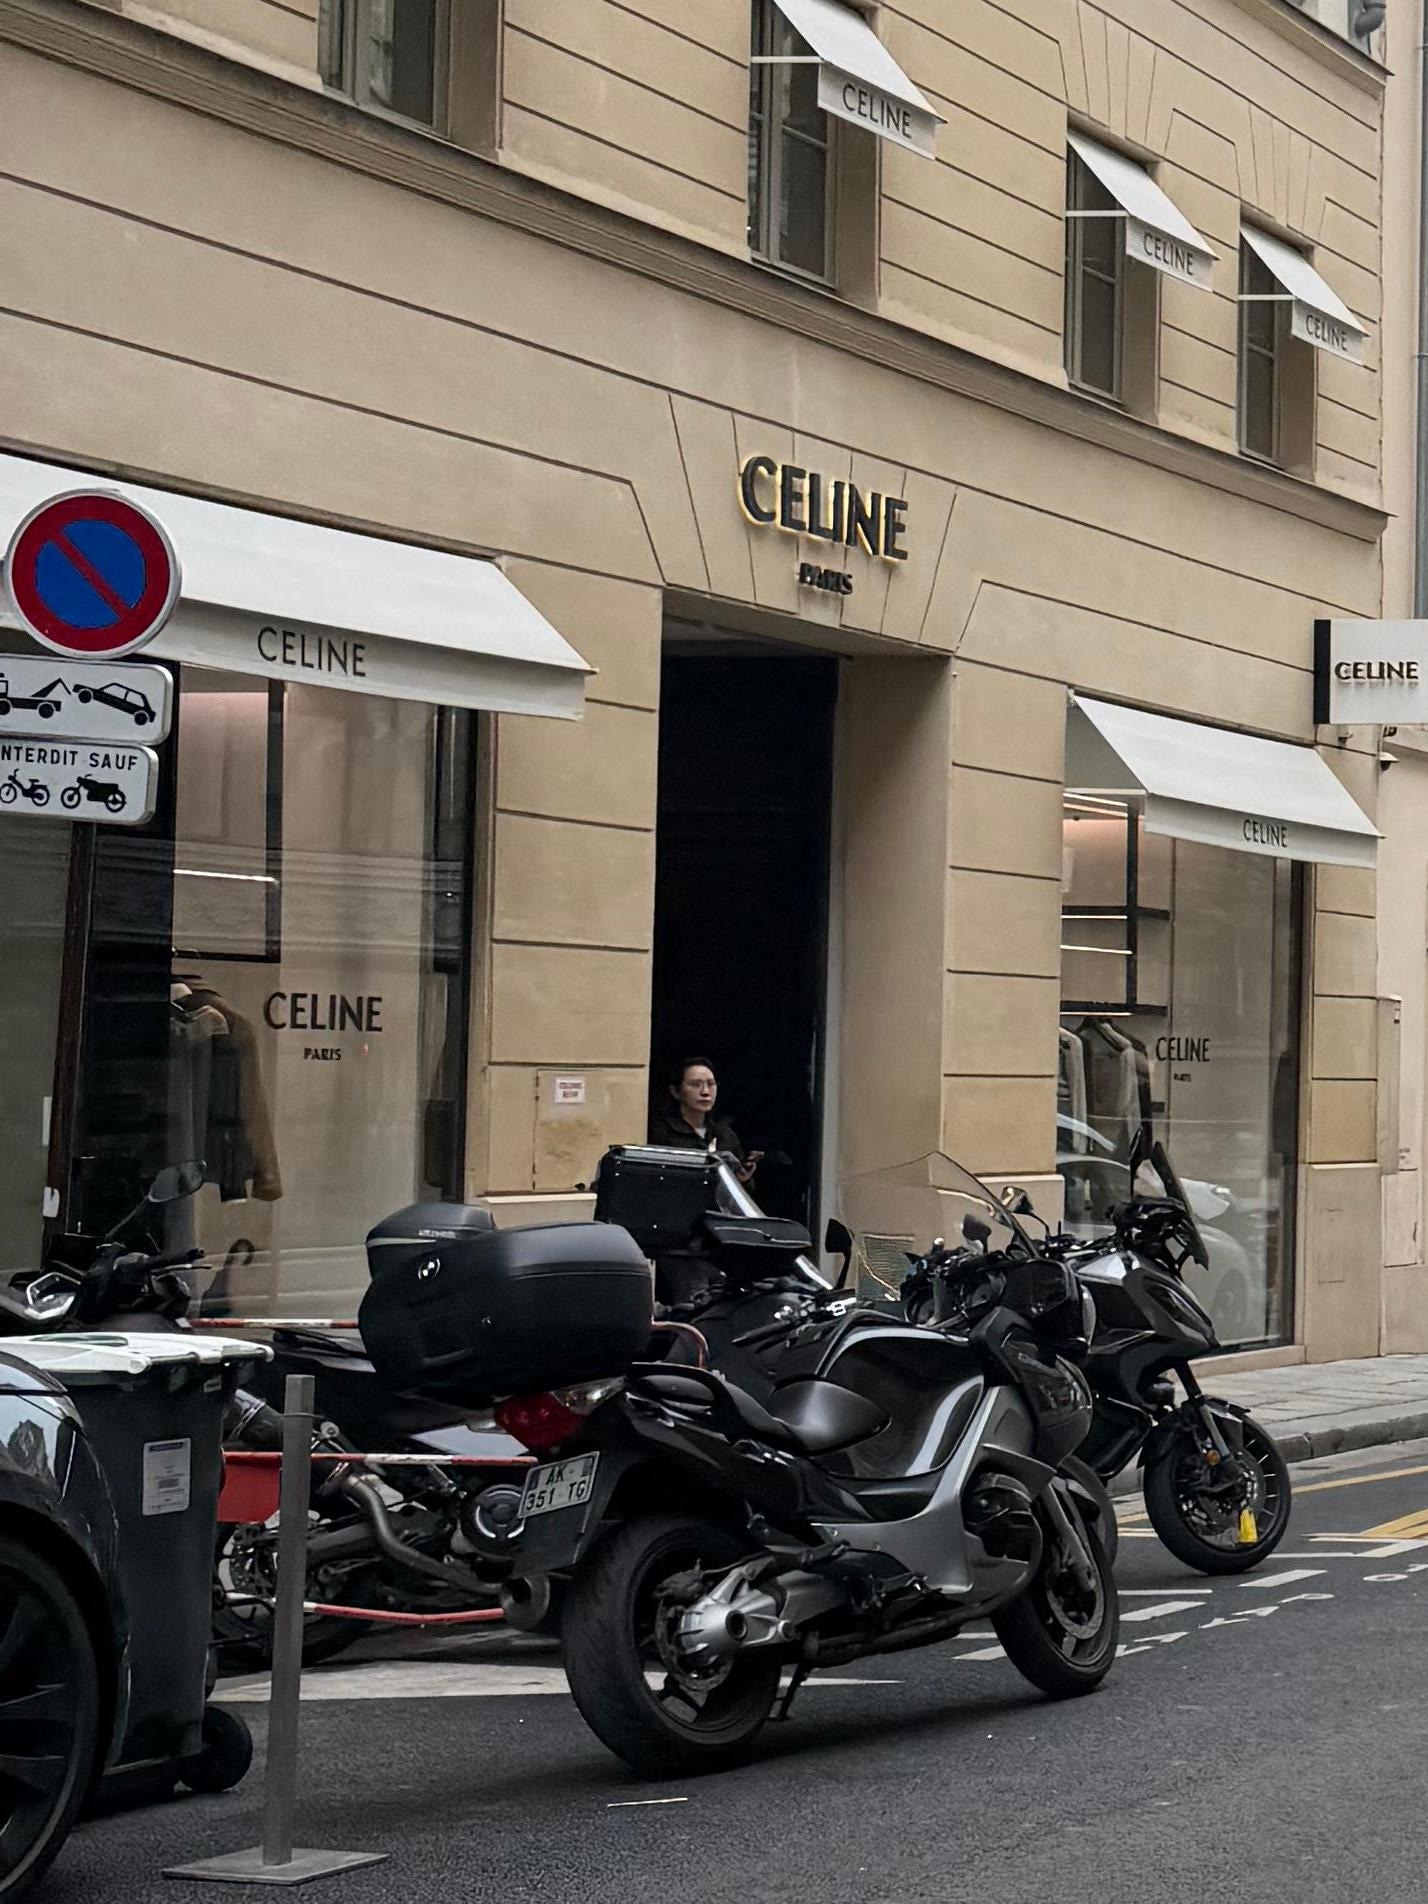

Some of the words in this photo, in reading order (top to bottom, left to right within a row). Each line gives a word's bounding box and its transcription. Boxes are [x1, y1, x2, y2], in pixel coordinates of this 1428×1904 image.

[842, 83, 913, 140] CELINE
[1143, 232, 1195, 277] CELINE
[1305, 313, 1349, 352] CELINE
[741, 456, 909, 560] CELINE
[257, 625, 368, 678] CELINE
[1334, 658, 1420, 682] CELINE
[0, 745, 78, 766] NTERDIT
[89, 752, 138, 770] SAUF
[1242, 818, 1289, 849] CELINE
[263, 992, 383, 1032] CELINE
[304, 1048, 341, 1061] PARIS
[1156, 1037, 1211, 1063] CELINE
[526, 1488, 555, 1510] 351
